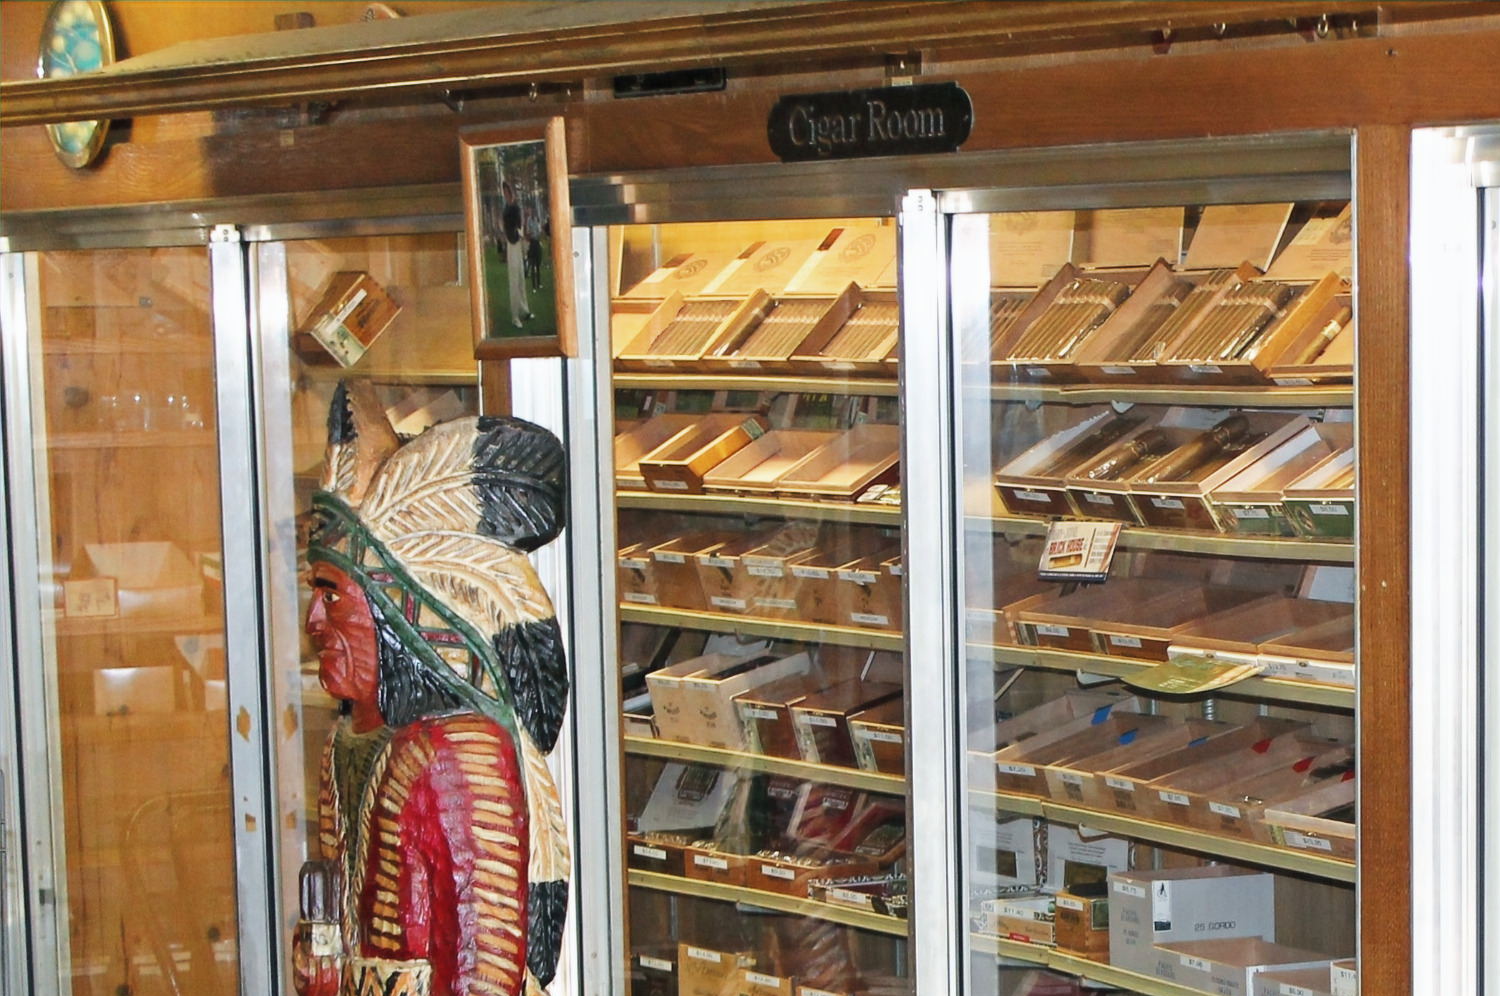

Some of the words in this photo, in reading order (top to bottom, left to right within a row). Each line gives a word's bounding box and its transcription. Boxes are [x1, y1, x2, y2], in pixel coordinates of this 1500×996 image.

[789, 105, 861, 155] Cigar
[867, 101, 946, 141] Room
[1066, 538, 1084, 552] HOUSE
[1194, 921, 1206, 931] 25
[1208, 920, 1236, 931] GORDO
